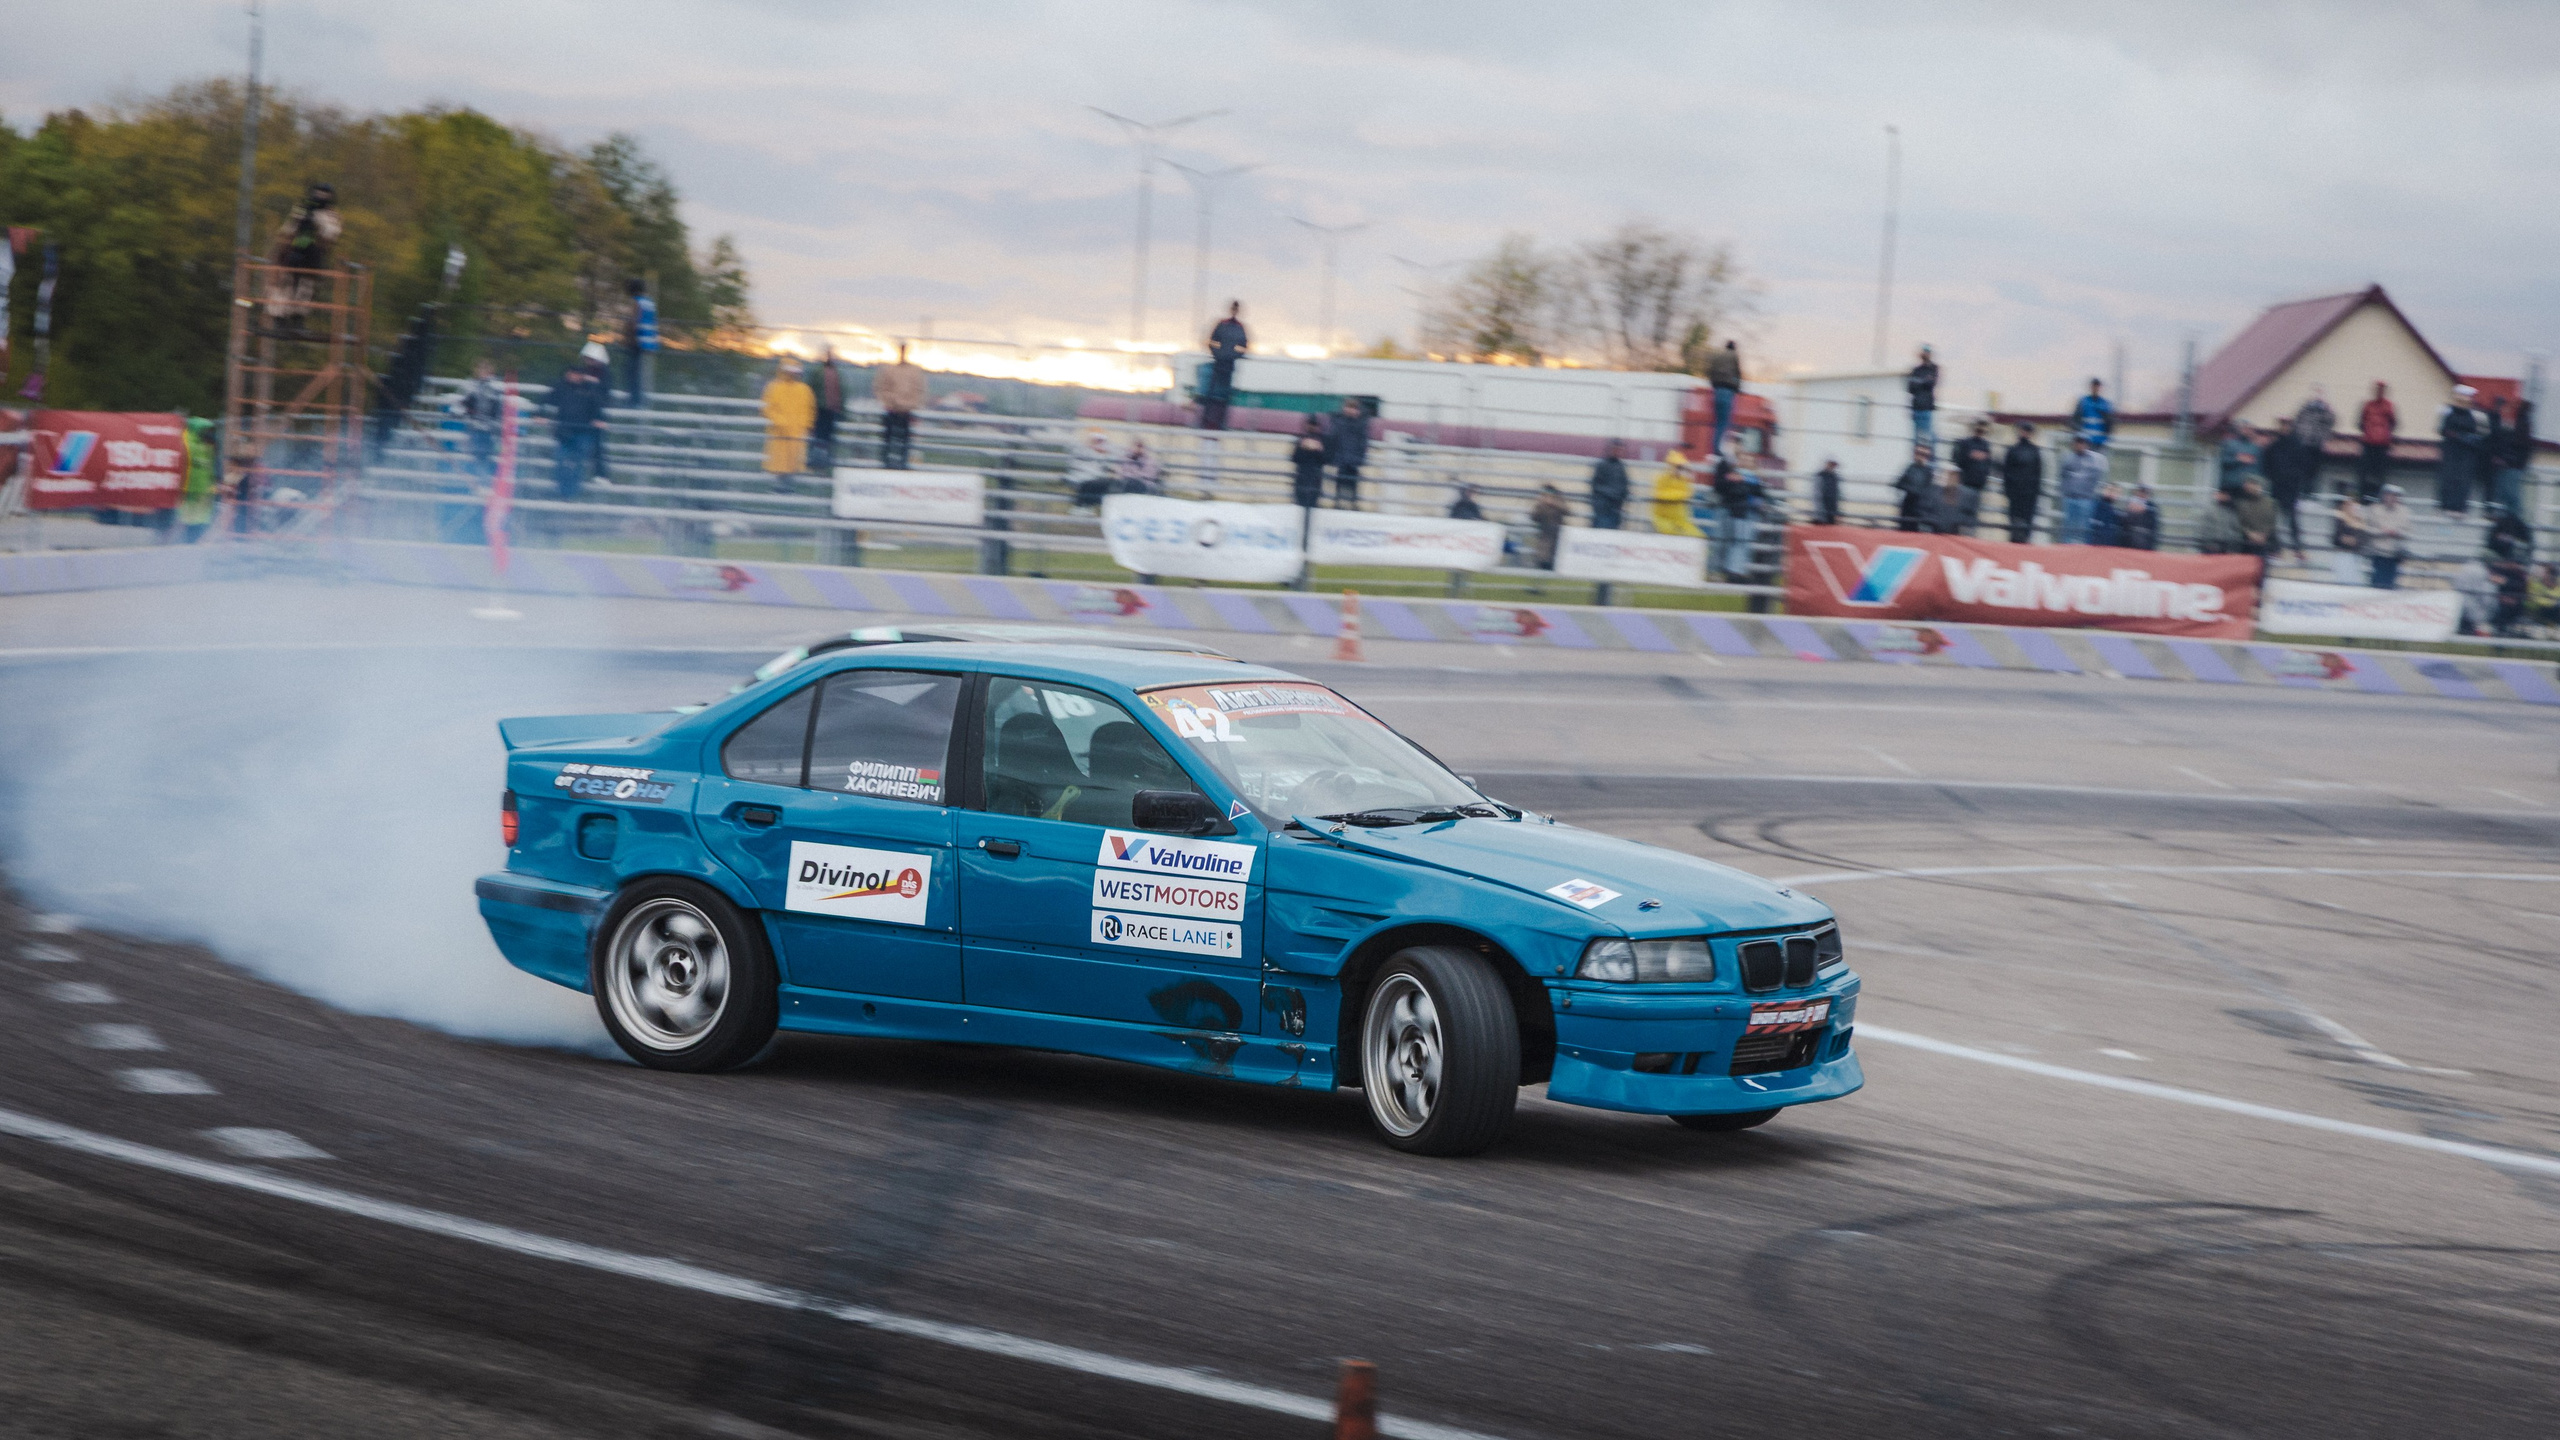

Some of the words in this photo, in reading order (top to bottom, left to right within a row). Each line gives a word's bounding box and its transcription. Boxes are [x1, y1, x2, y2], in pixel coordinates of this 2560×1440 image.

[1940, 555, 2224, 622] Valvoline
[1172, 707, 1246, 743] 42
[849, 760, 916, 782] ФИЛИПП
[844, 776, 941, 801] ХАСИНЕВИЧ
[1150, 847, 1244, 875] Valvoline
[799, 860, 891, 891] Divinol
[901, 879, 917, 889] DAS
[1100, 879, 1239, 911] WESTMOTORS
[1126, 923, 1168, 941] RACE
[1172, 929, 1217, 946] LANE
